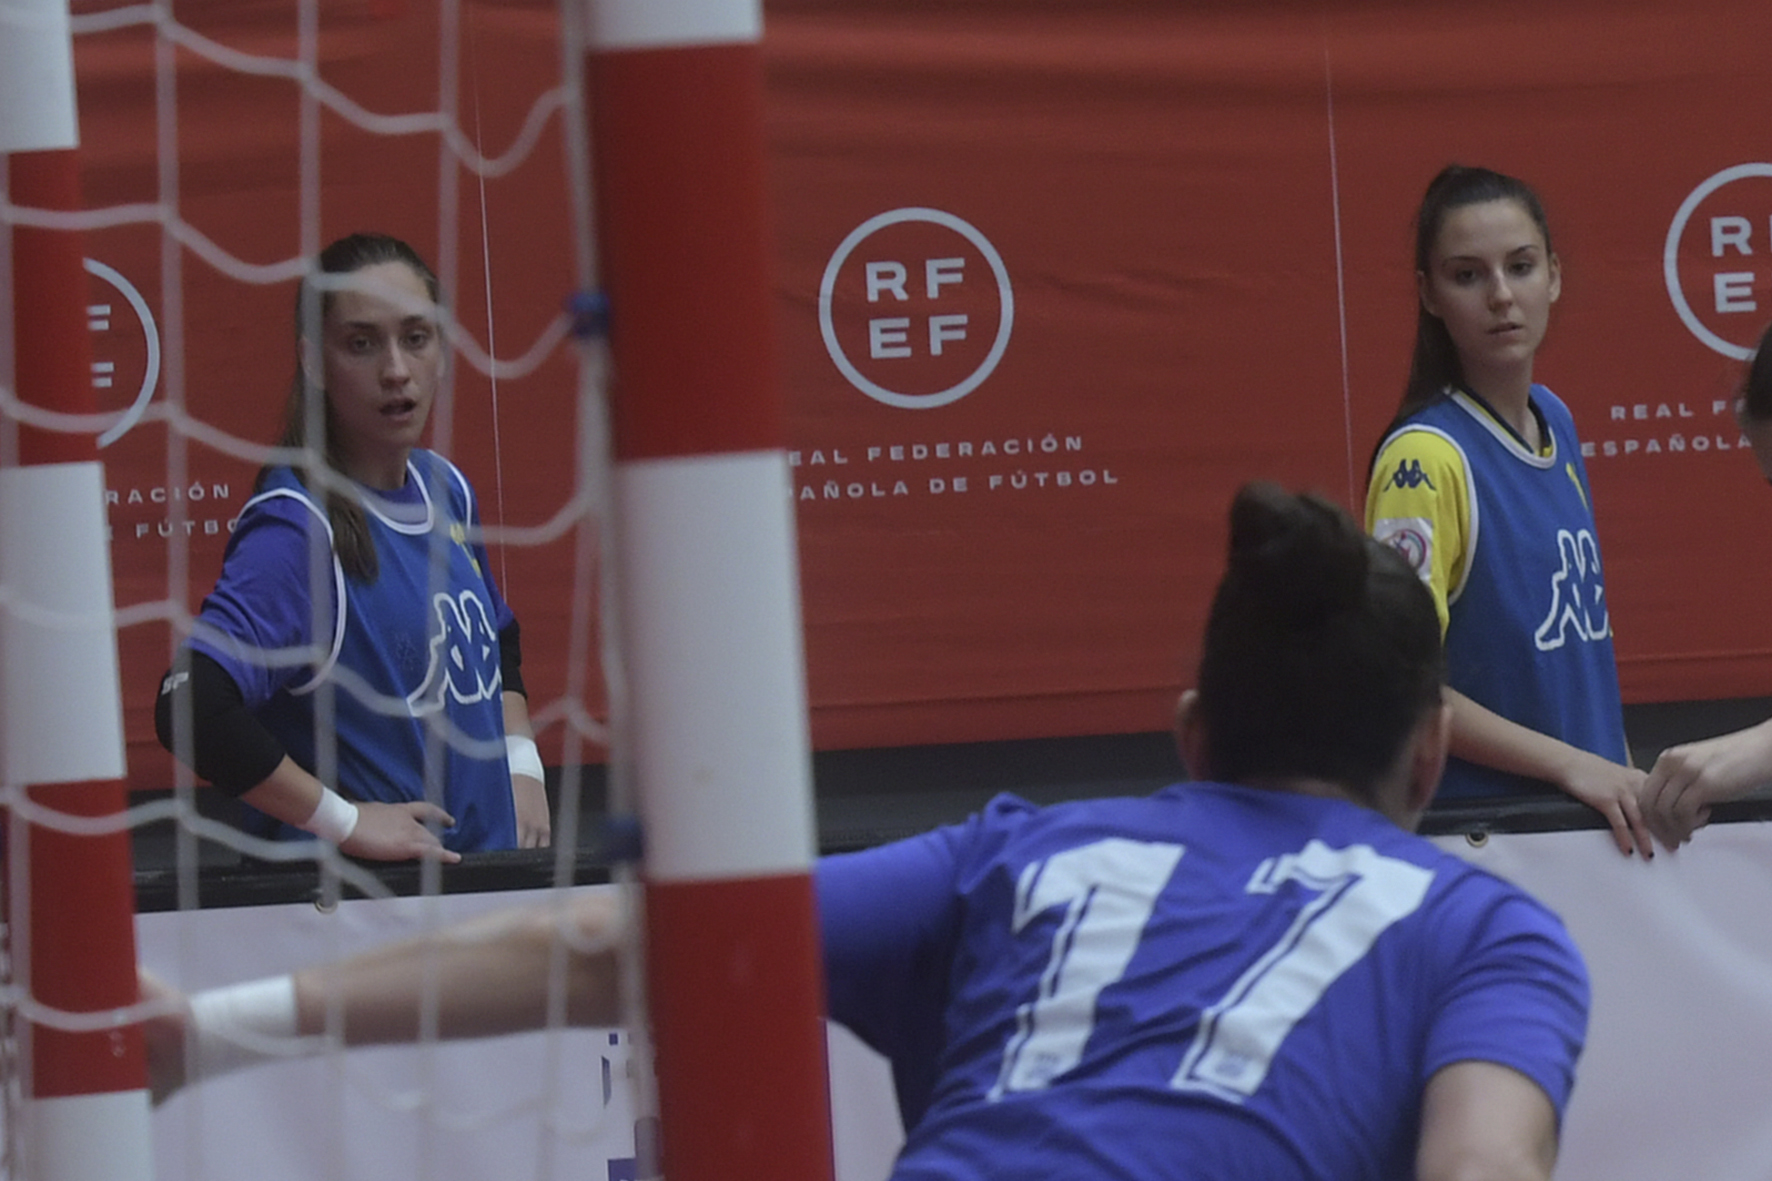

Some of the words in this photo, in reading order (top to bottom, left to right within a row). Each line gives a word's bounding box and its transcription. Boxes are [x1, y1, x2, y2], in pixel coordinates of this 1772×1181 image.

[864, 257, 966, 302] RF
[867, 314, 969, 360] EF
[1610, 403, 1694, 421] REAL
[788, 449, 848, 466] EAL
[867, 432, 1082, 462] FEDERACIÓN
[1580, 434, 1752, 457] ESPAÑOLA
[104, 480, 229, 505] RACIÓN
[799, 480, 909, 500] AÑOLA
[929, 477, 968, 495] DE
[989, 469, 1118, 491] FÚTBOL
[135, 517, 238, 539] FÚTBO
[986, 837, 1436, 1104] 17
